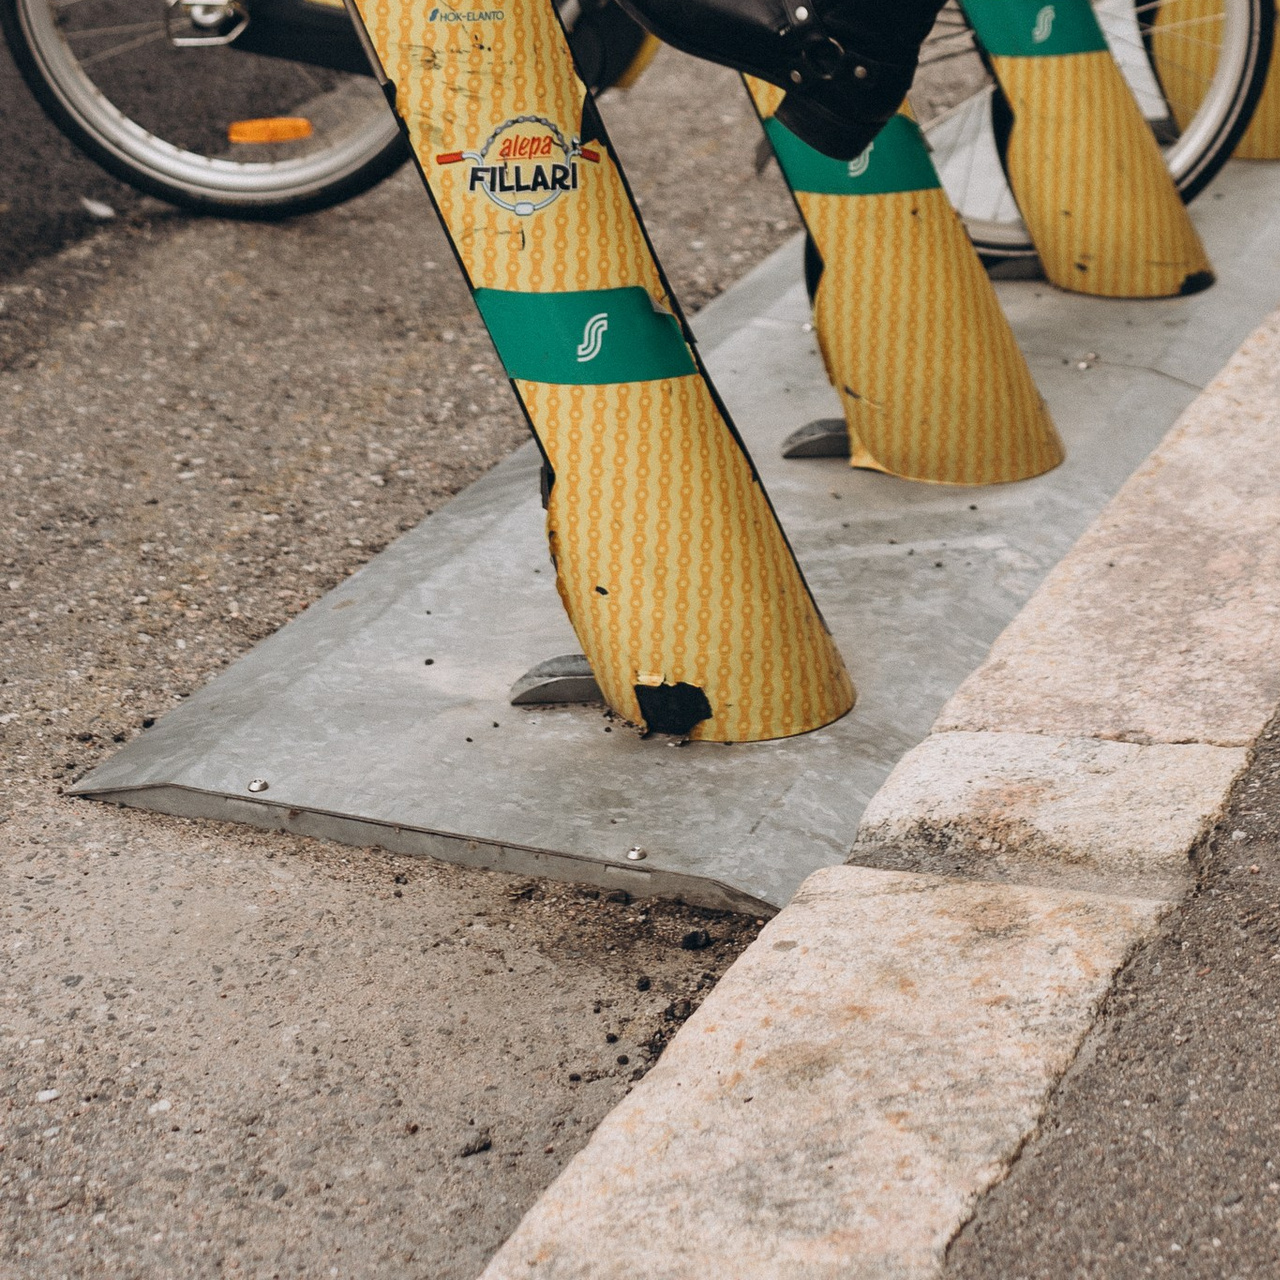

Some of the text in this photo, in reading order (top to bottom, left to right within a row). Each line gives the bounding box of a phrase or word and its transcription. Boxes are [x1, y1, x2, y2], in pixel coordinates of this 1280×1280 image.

[440, 10, 504, 22] HOK-ELANTO
[499, 134, 553, 159] alepa
[469, 162, 578, 192] FILLARI
